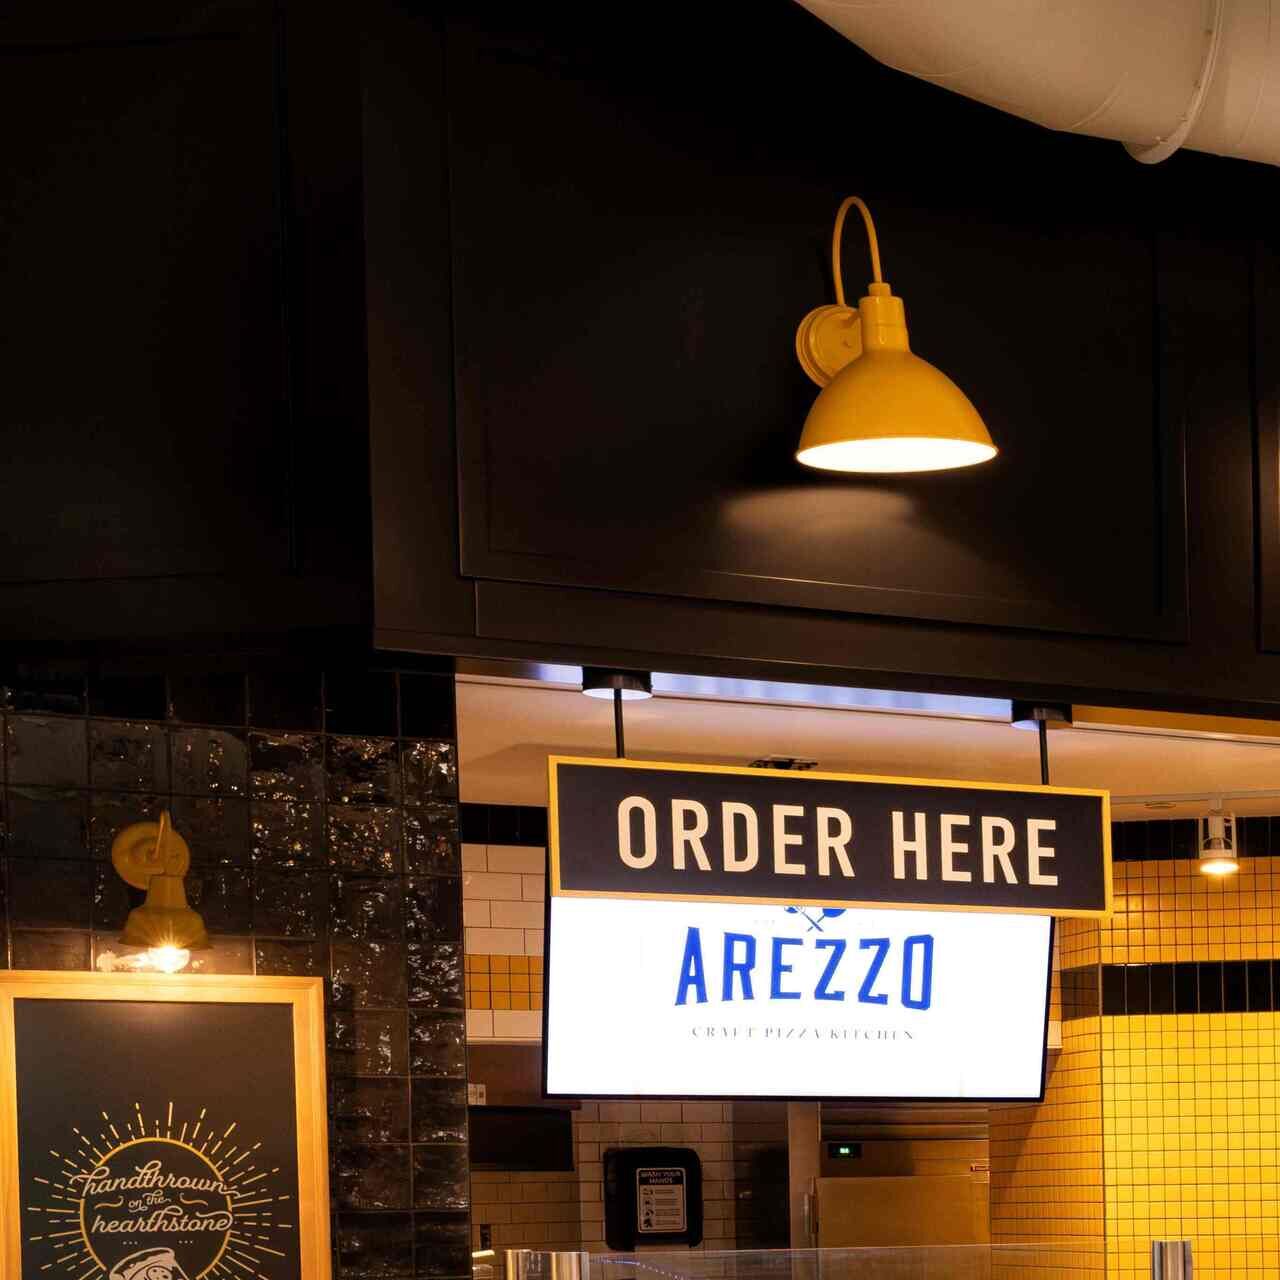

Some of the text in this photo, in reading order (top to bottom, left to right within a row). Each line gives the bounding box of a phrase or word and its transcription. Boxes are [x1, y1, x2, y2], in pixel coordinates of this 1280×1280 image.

[617, 795, 1059, 887] ORDER HERE
[675, 926, 935, 1011] AREZZO
[691, 1026, 914, 1041] CRAFT PIZZA KITCHEN
[69, 1160, 241, 1196] handthrown
[128, 1189, 172, 1212] on the
[91, 1205, 234, 1233] hearthstone
